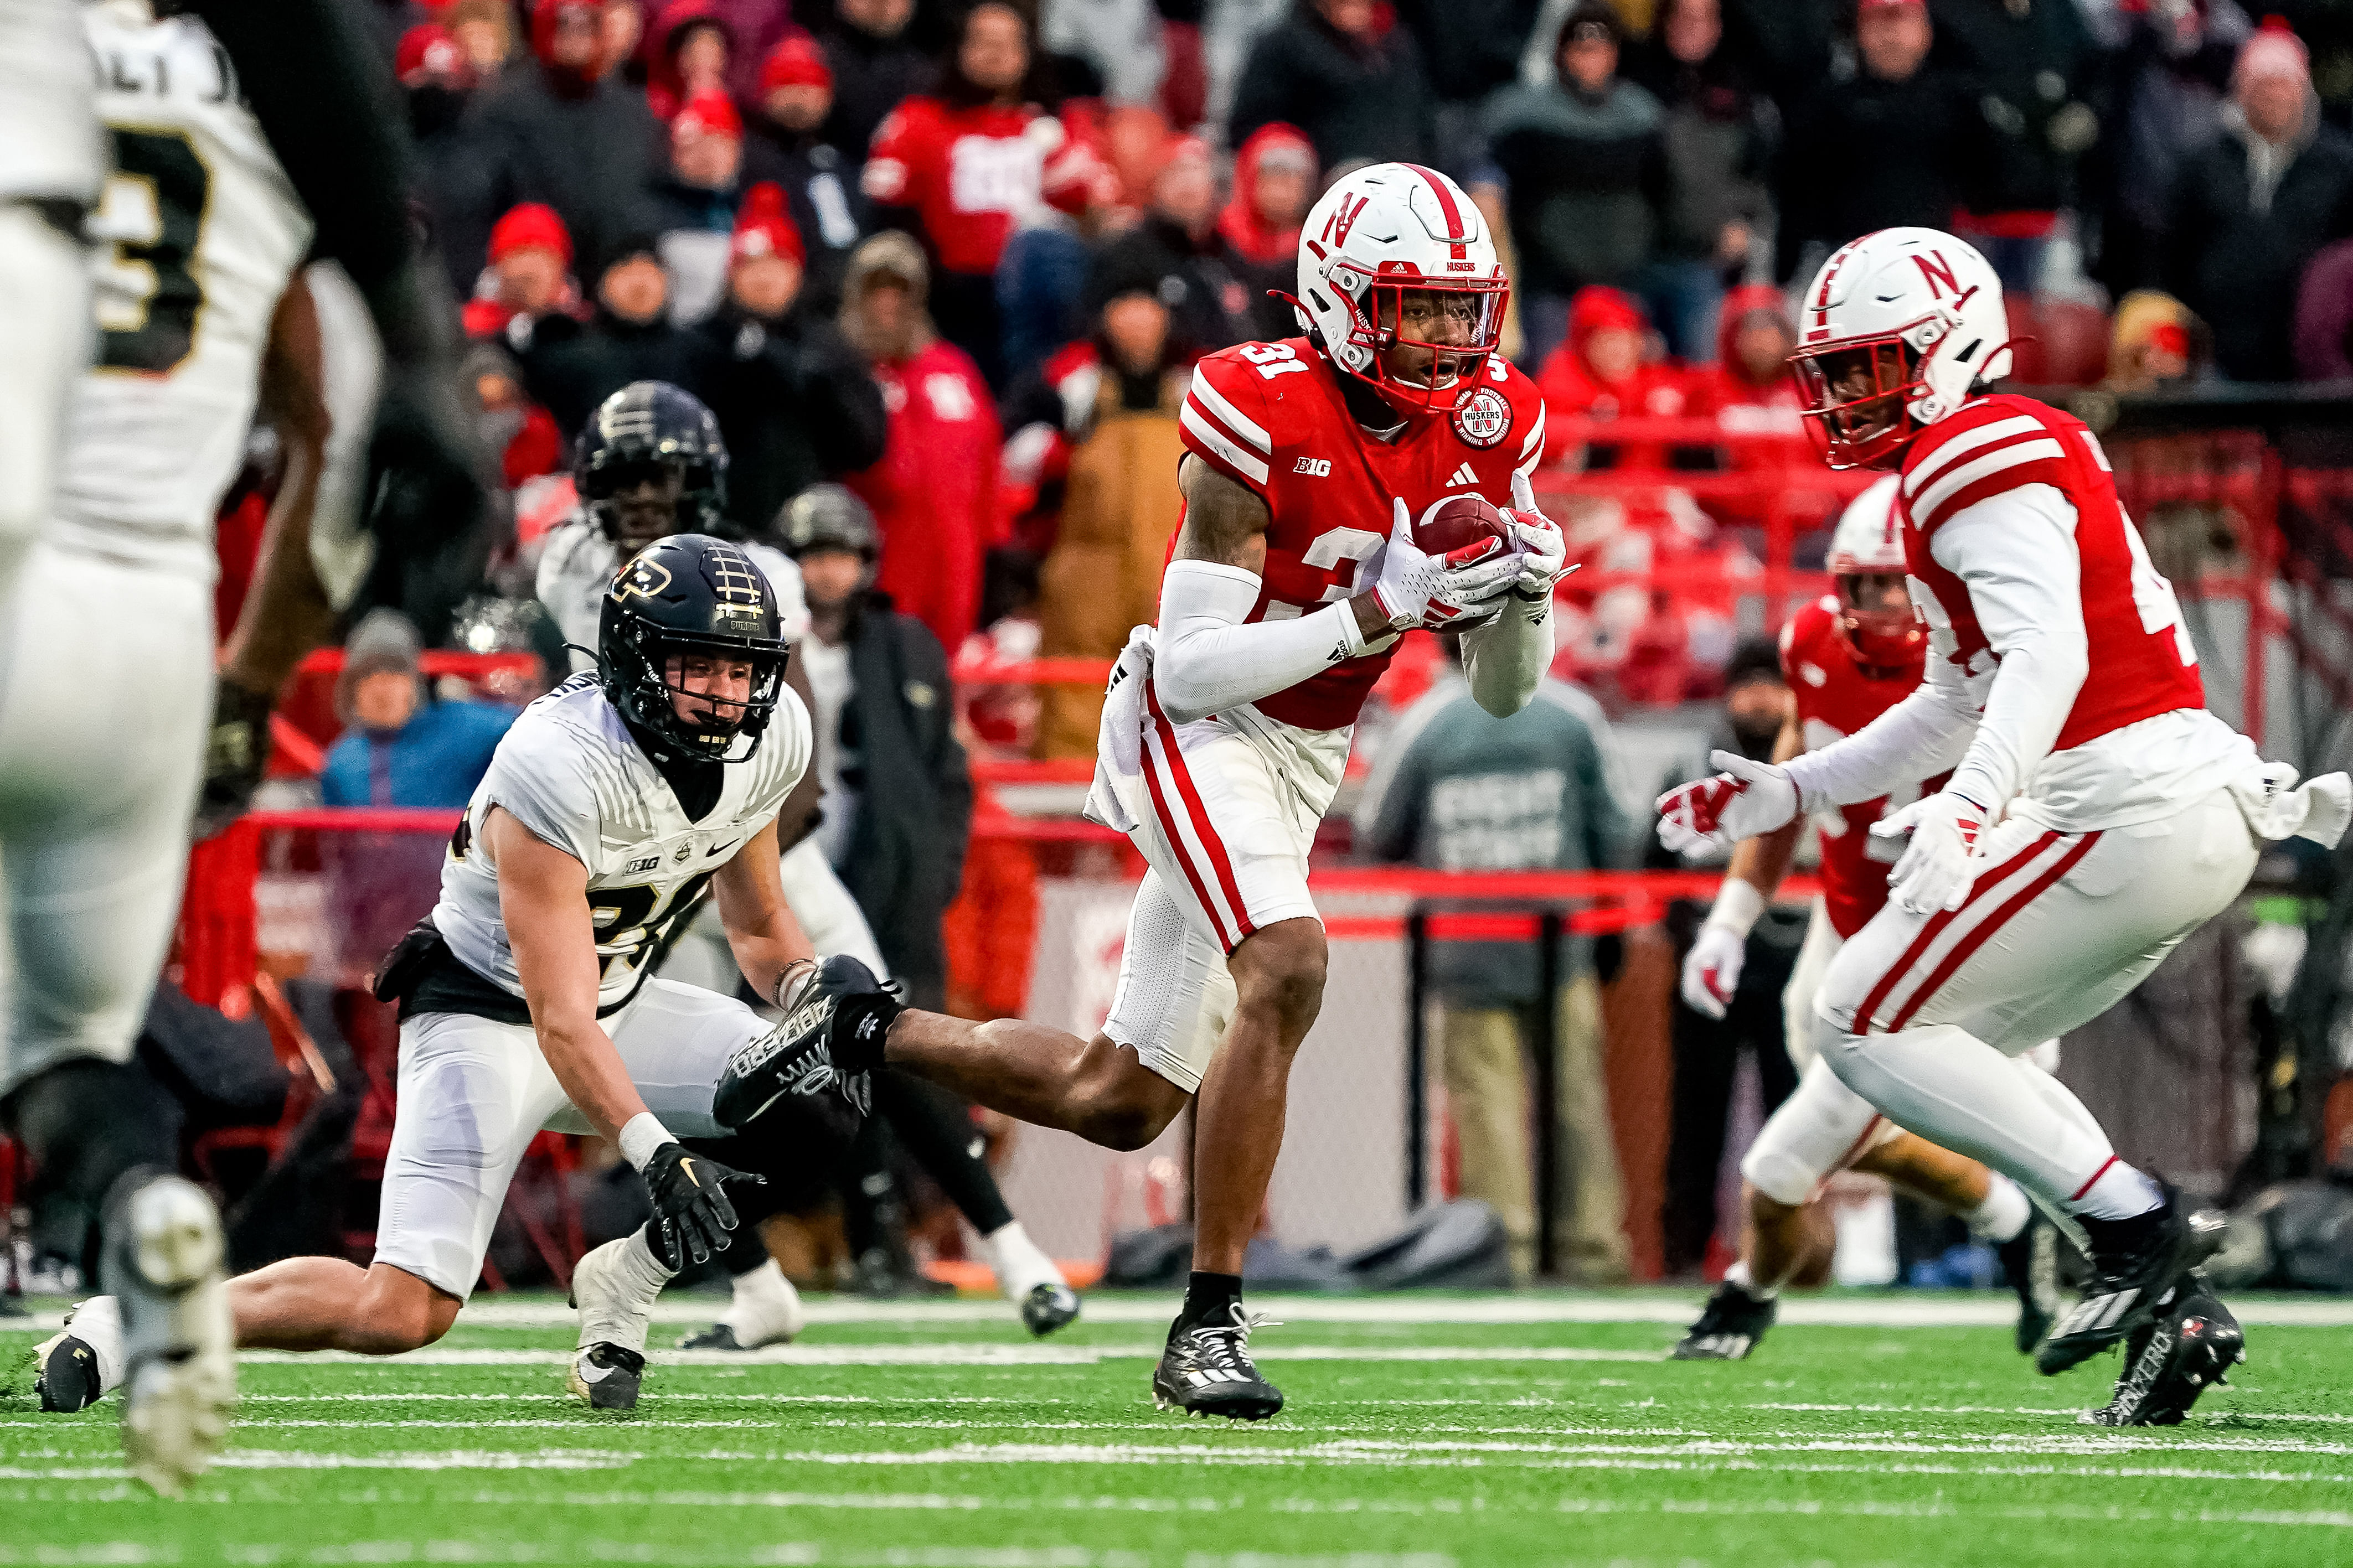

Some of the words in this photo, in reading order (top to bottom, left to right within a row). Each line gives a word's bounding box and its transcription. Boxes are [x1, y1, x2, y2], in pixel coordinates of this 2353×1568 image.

[1447, 262, 1475, 272] HUSKERS
[1239, 343, 1309, 380] 31
[1464, 411, 1500, 421] HUSKERS
[1487, 418, 1510, 445] TRADITION
